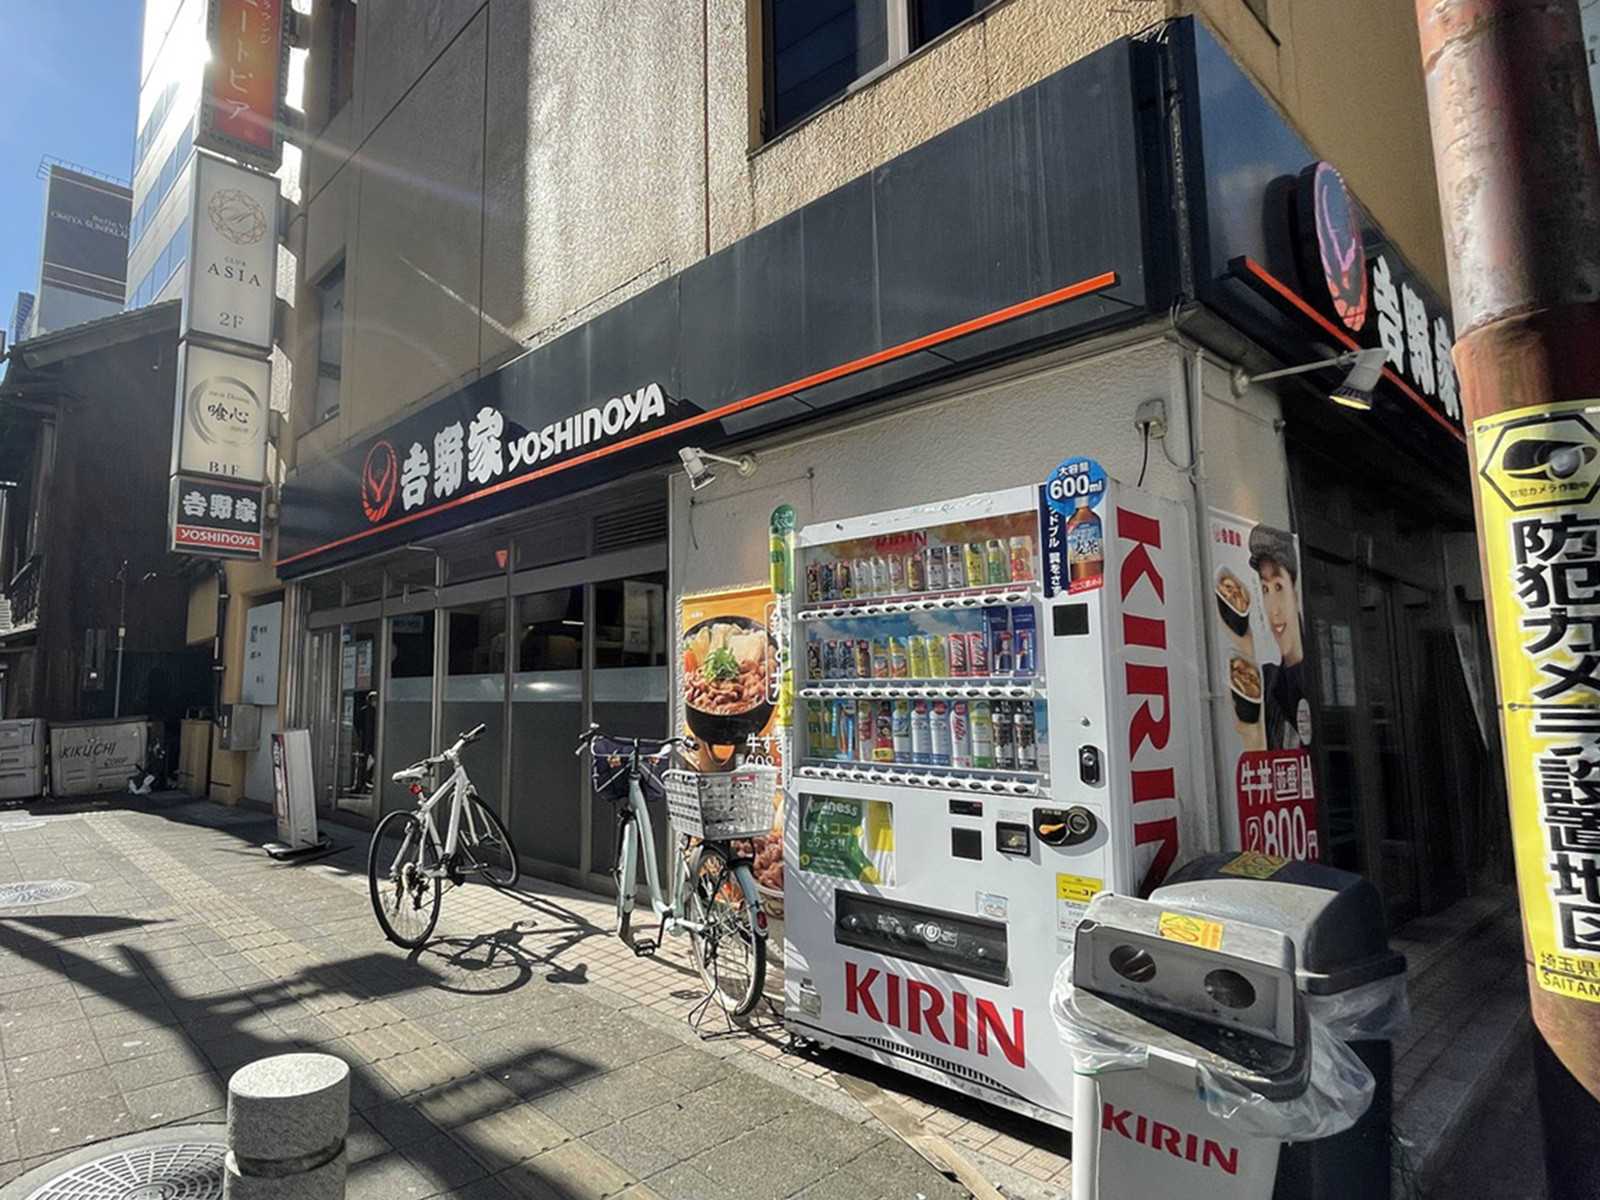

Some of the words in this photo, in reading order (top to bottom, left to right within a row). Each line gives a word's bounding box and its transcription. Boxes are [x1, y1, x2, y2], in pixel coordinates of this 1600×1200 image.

[226, 0, 258, 119] ートピア
[207, 262, 262, 287] ASIA
[219, 311, 245, 329] 2F
[208, 460, 241, 476] B1F
[400, 405, 504, 511] 吉野家
[1058, 461, 1091, 477] 大容量
[1049, 474, 1103, 501] 600ml
[182, 491, 258, 524] 吉野家
[1116, 506, 1179, 899] KIRIN
[1511, 514, 1600, 951] 防犯カメラ設置地区
[61, 742, 116, 758] KIKUCHI
[845, 961, 1026, 1069] KIRIN
[1101, 1102, 1238, 1175] KIRIN
